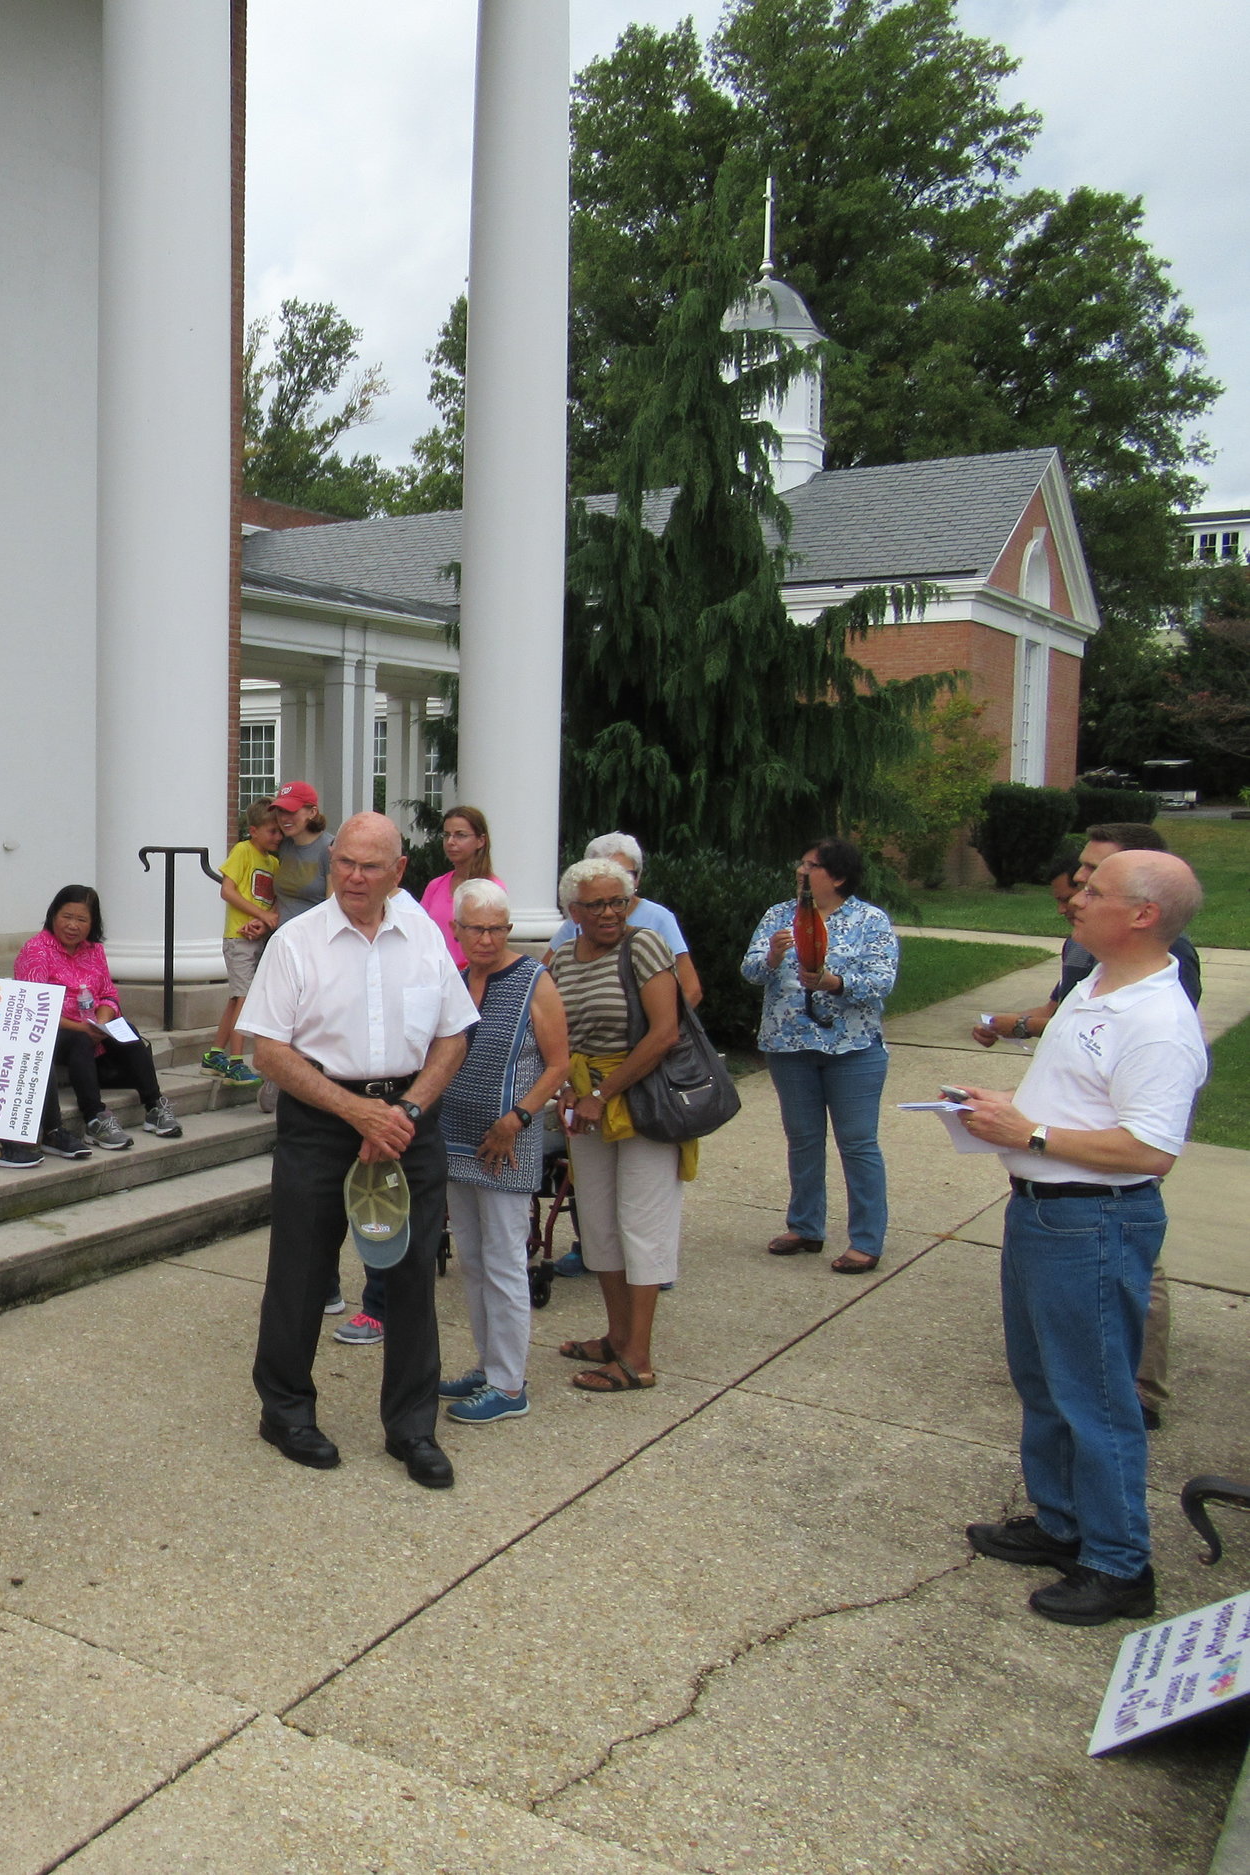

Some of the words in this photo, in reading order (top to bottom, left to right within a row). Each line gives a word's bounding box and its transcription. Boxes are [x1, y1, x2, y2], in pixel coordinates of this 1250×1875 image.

[2, 995, 16, 1032] HOUSING
[10, 988, 27, 1041] AFFORDABLE
[24, 1007, 35, 1022] for
[29, 992, 50, 1043] UNITED
[0, 1055, 15, 1092] Walk
[16, 1052, 31, 1097] Methodist
[31, 1050, 44, 1075] Silver
[25, 1077, 39, 1104] Spring
[9, 1098, 22, 1130] Cluster
[21, 1107, 34, 1136] United
